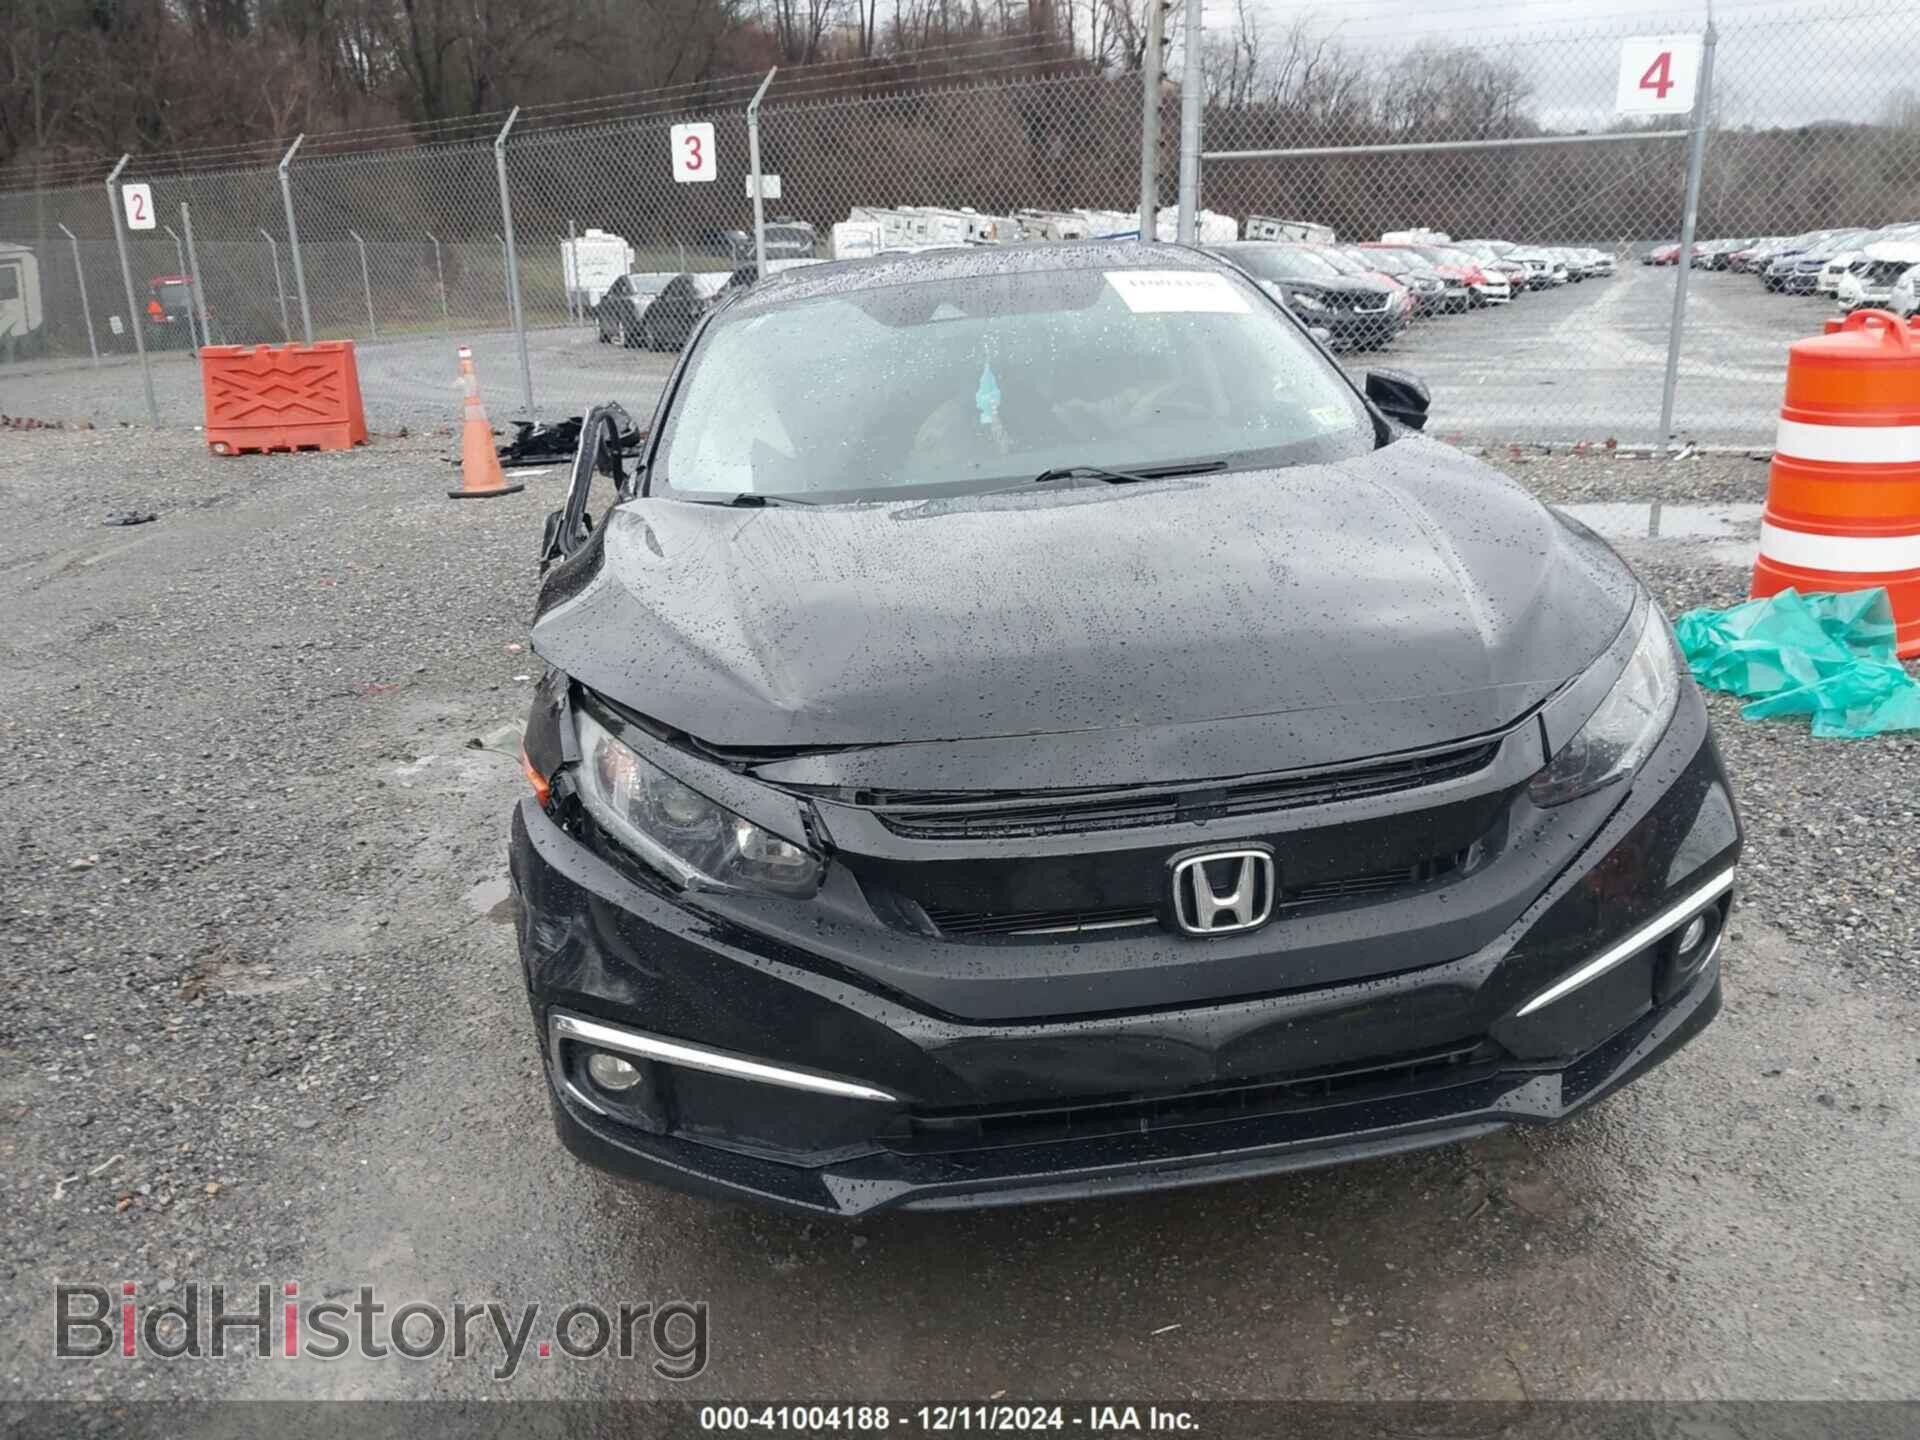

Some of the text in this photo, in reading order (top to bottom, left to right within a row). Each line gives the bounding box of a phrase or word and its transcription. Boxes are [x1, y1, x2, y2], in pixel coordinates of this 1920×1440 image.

[1639, 52, 1674, 98] 4
[684, 135, 703, 170] 3
[131, 193, 147, 220] 2
